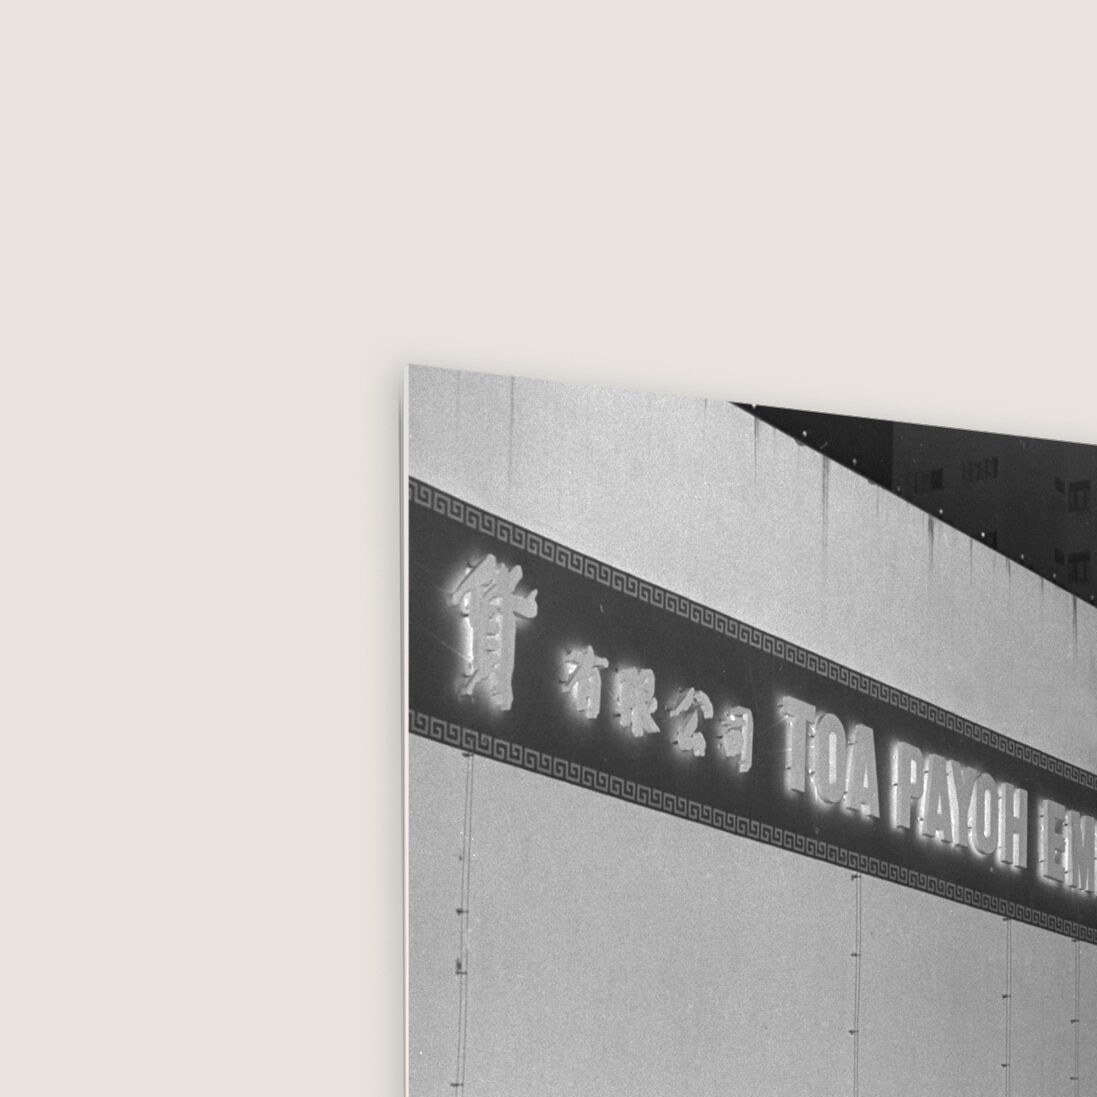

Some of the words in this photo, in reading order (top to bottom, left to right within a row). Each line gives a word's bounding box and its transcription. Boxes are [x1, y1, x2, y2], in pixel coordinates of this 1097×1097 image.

[557, 645, 753, 772] 有限公司
[778, 696, 880, 818] TOA
[890, 741, 1028, 869] PAYOH
